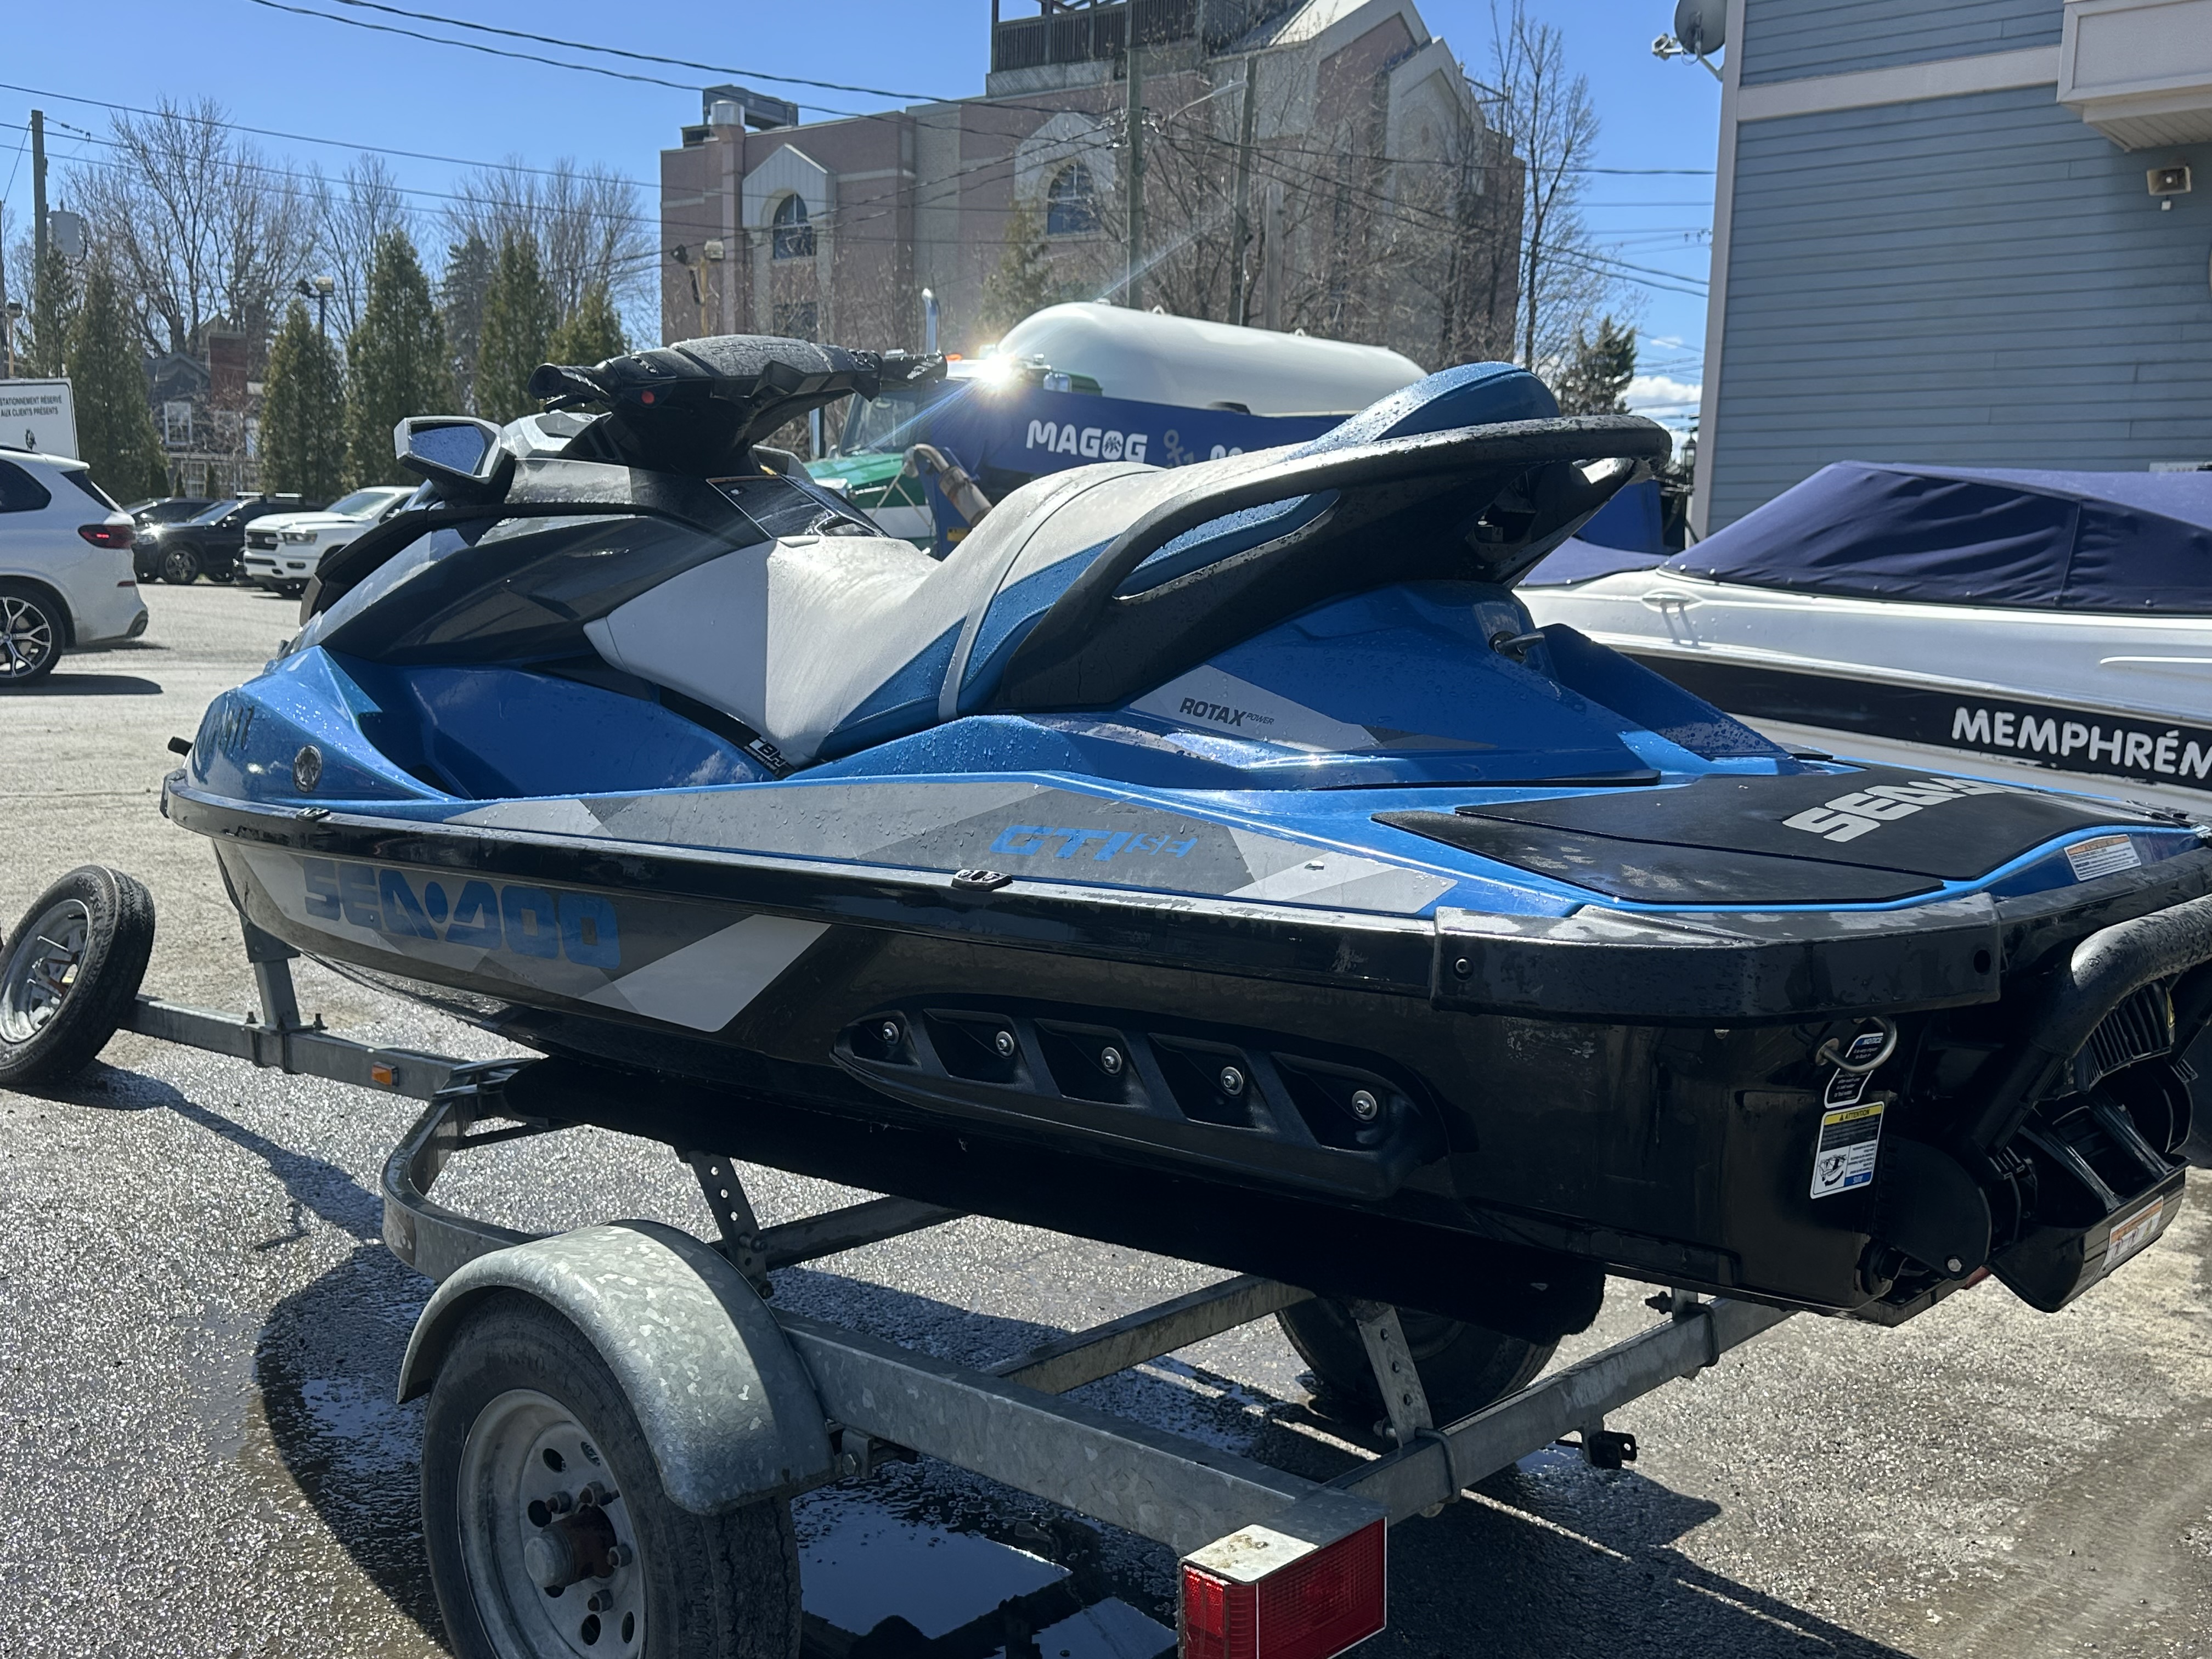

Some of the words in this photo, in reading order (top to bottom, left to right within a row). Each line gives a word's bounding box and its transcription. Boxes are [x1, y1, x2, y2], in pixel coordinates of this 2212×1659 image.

[1, 408, 11, 417] AUX
[12, 407, 33, 417] CLIENTS
[1026, 419, 1148, 464] MAGOG
[1180, 697, 1247, 726] ROTAX
[1245, 713, 1274, 725] POWER
[1951, 706, 2212, 779] MEMPHRÉM
[989, 825, 1133, 861] GTI
[1845, 1109, 1870, 1120] ATTENTION
